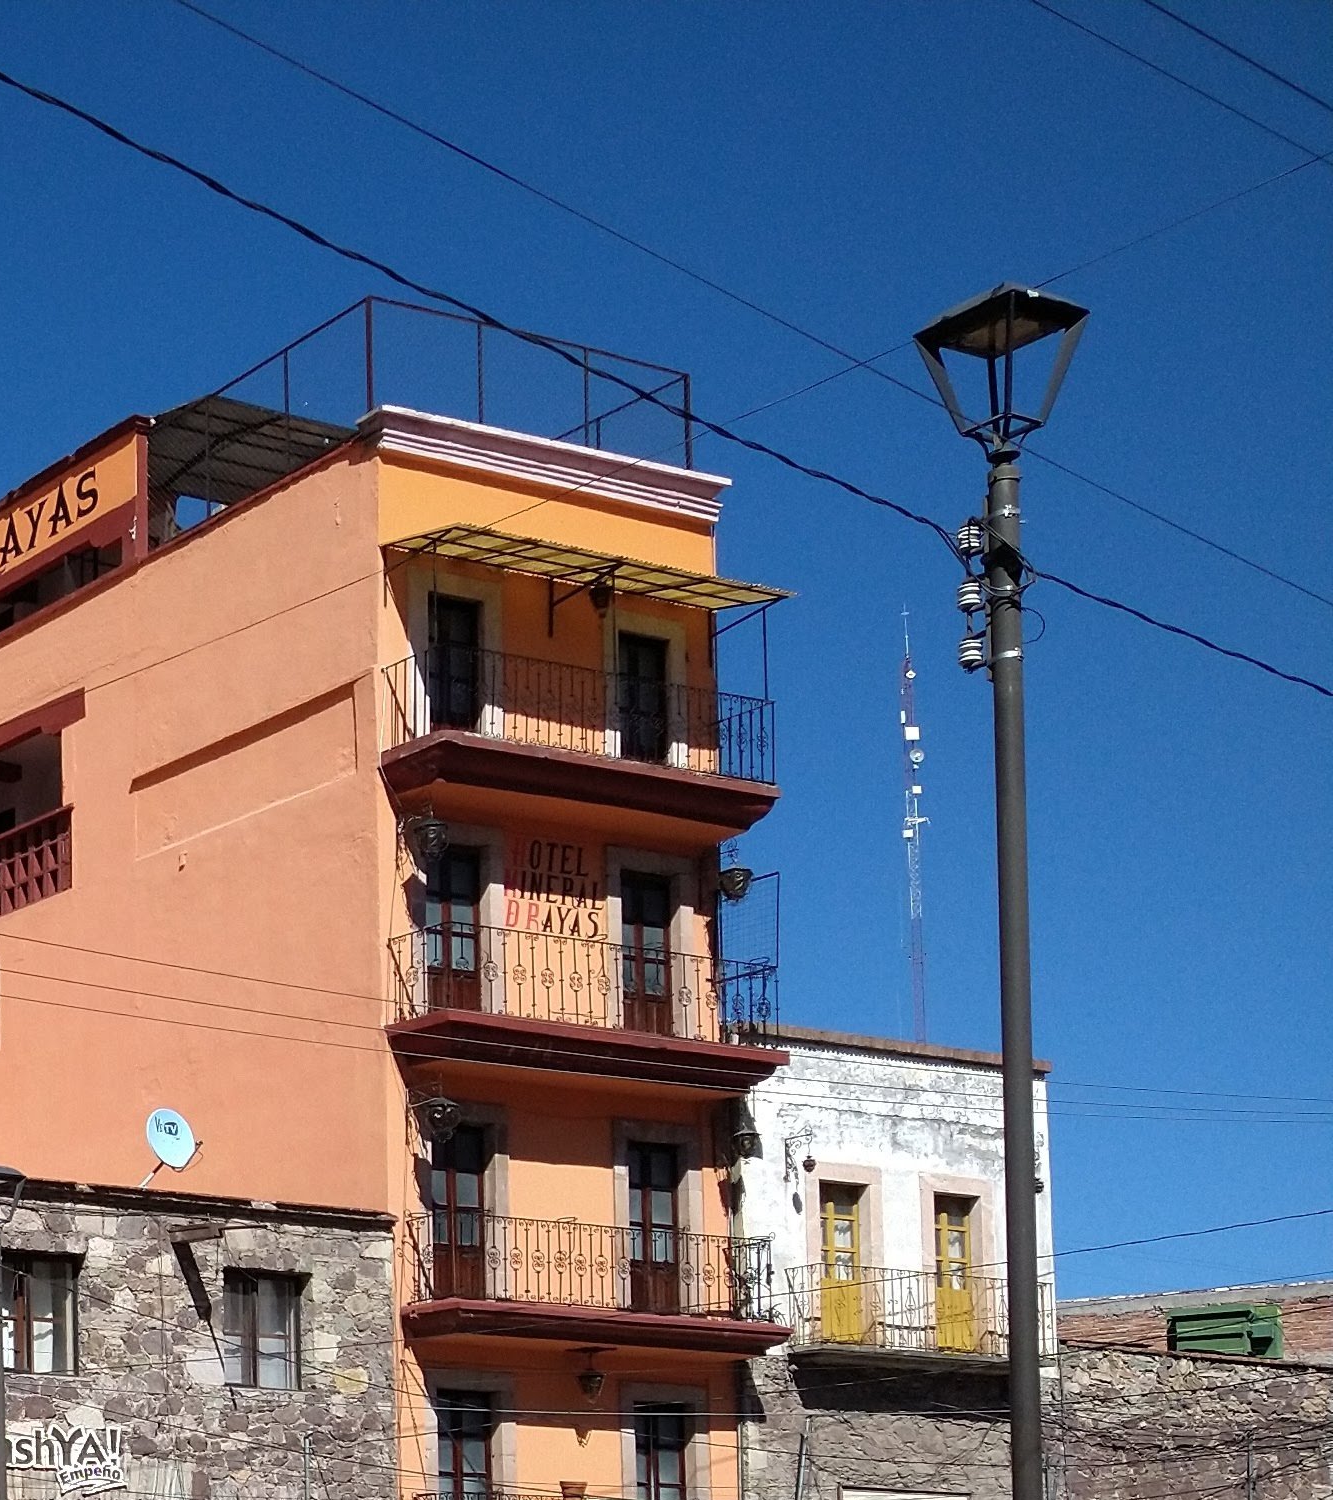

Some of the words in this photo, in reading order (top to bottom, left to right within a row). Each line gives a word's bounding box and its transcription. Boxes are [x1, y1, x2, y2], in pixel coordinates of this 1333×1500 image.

[503, 868, 605, 910] MINERAL
[525, 902, 608, 940] RAYAS
[59, 1466, 121, 1486] Empeño
